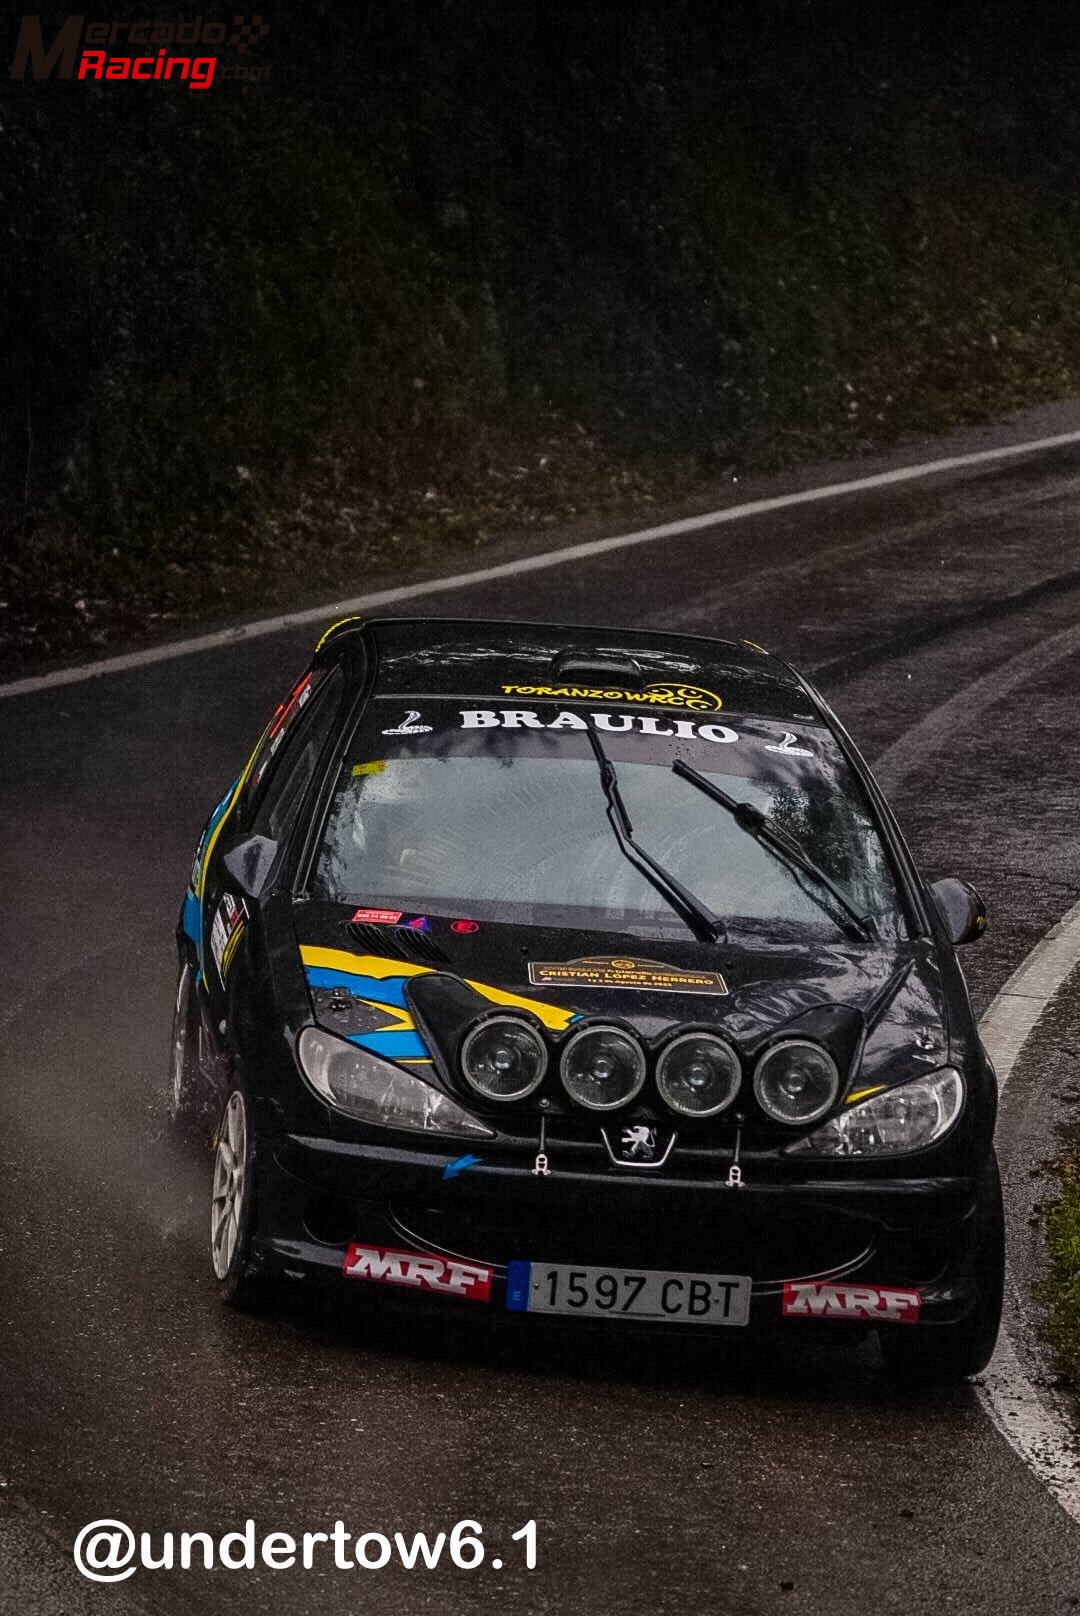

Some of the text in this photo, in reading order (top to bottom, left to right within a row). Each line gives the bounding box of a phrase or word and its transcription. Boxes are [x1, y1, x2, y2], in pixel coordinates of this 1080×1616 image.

[459, 709, 740, 744] BRAULIO
[539, 970, 599, 980] CRISTIAN
[651, 975, 714, 985] HERRERO
[347, 1247, 490, 1296] MRF
[545, 1270, 741, 1319] 1597 CBT
[785, 1283, 920, 1319] MRF
